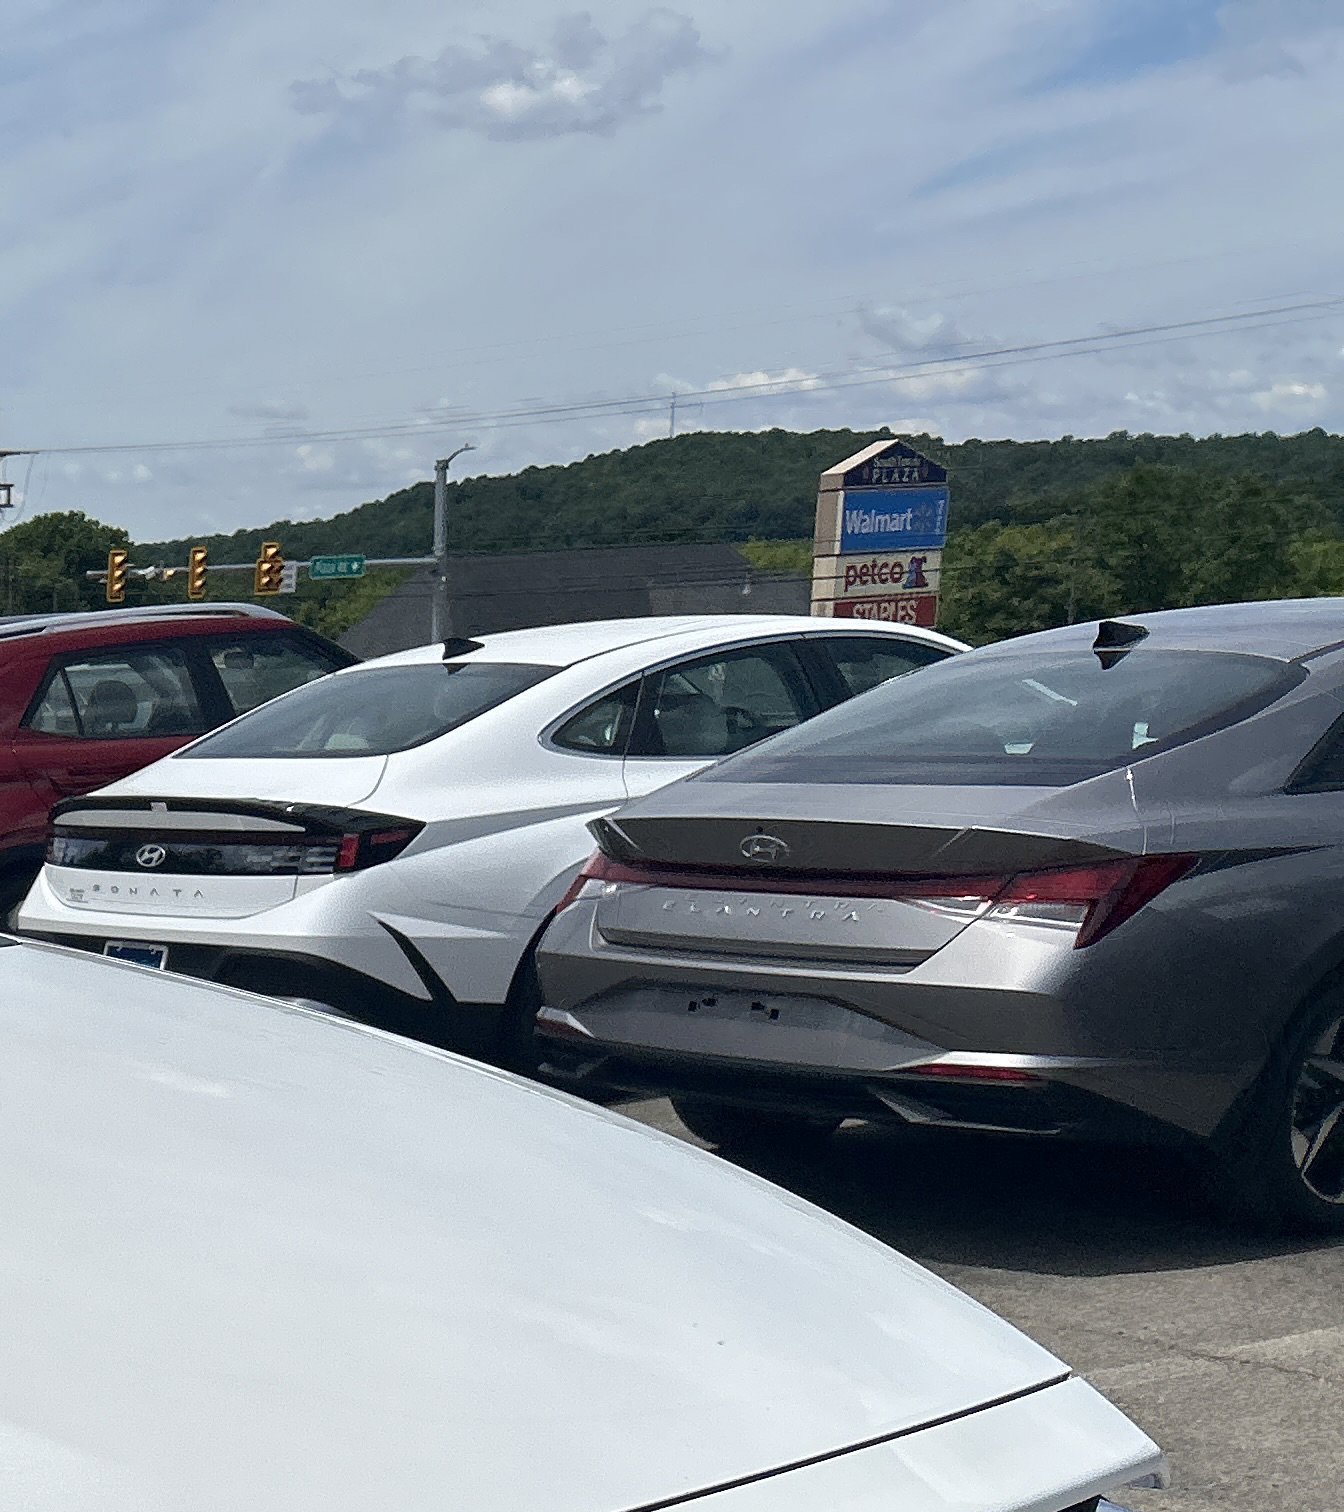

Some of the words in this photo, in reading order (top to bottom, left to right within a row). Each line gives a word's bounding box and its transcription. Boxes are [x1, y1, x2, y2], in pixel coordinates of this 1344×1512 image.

[845, 508, 912, 534] Walmart
[844, 558, 904, 592] petco
[93, 884, 204, 898] SONATA
[662, 900, 860, 922] ELANTRA
